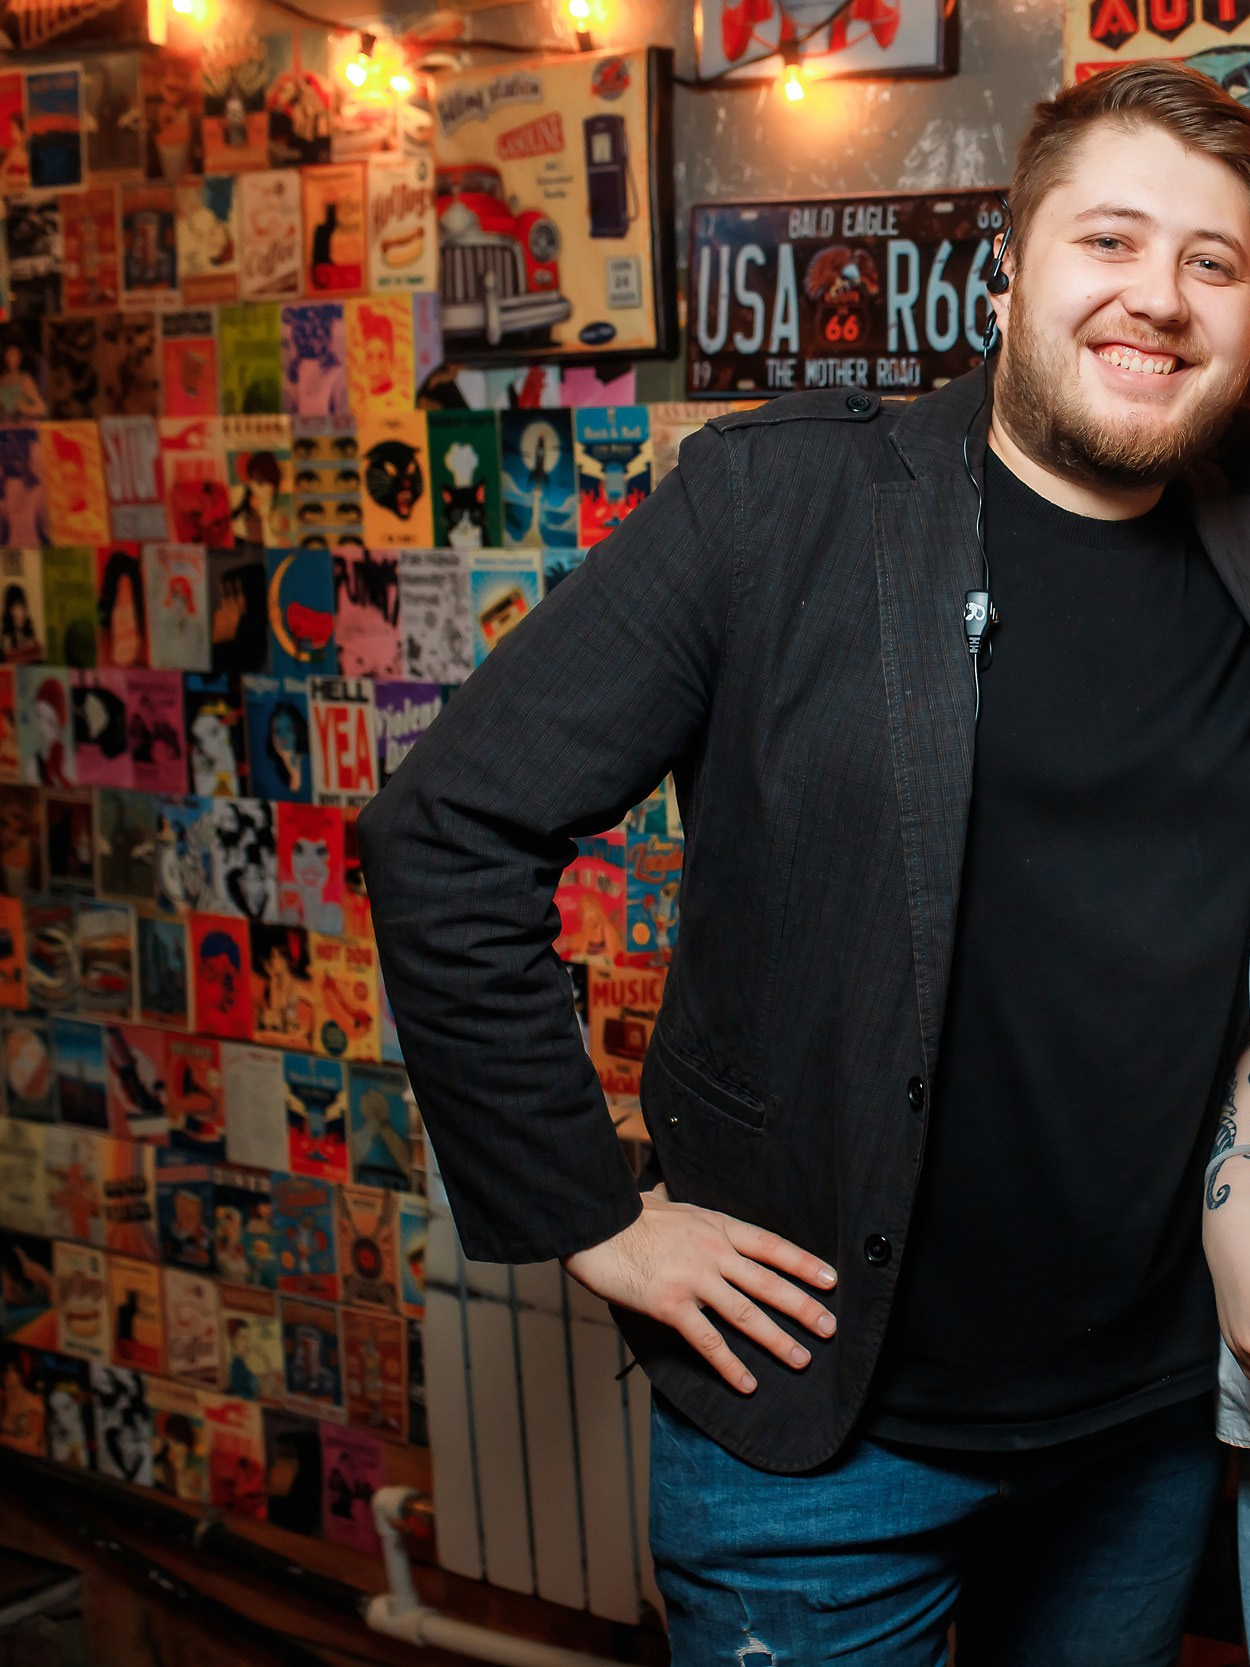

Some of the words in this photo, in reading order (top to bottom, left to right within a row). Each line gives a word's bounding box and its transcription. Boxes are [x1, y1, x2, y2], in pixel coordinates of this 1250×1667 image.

[788, 208, 835, 239] BALD
[842, 204, 899, 237] EAGLE
[697, 242, 800, 355] USA
[887, 238, 999, 354] R66
[824, 313, 860, 342] 66
[765, 359, 794, 388] THE
[804, 357, 869, 388] MOTHER
[876, 357, 921, 388] ROAD
[311, 681, 369, 702] HELL
[313, 704, 375, 792] YEA
[593, 979, 662, 1007] MUSIC
